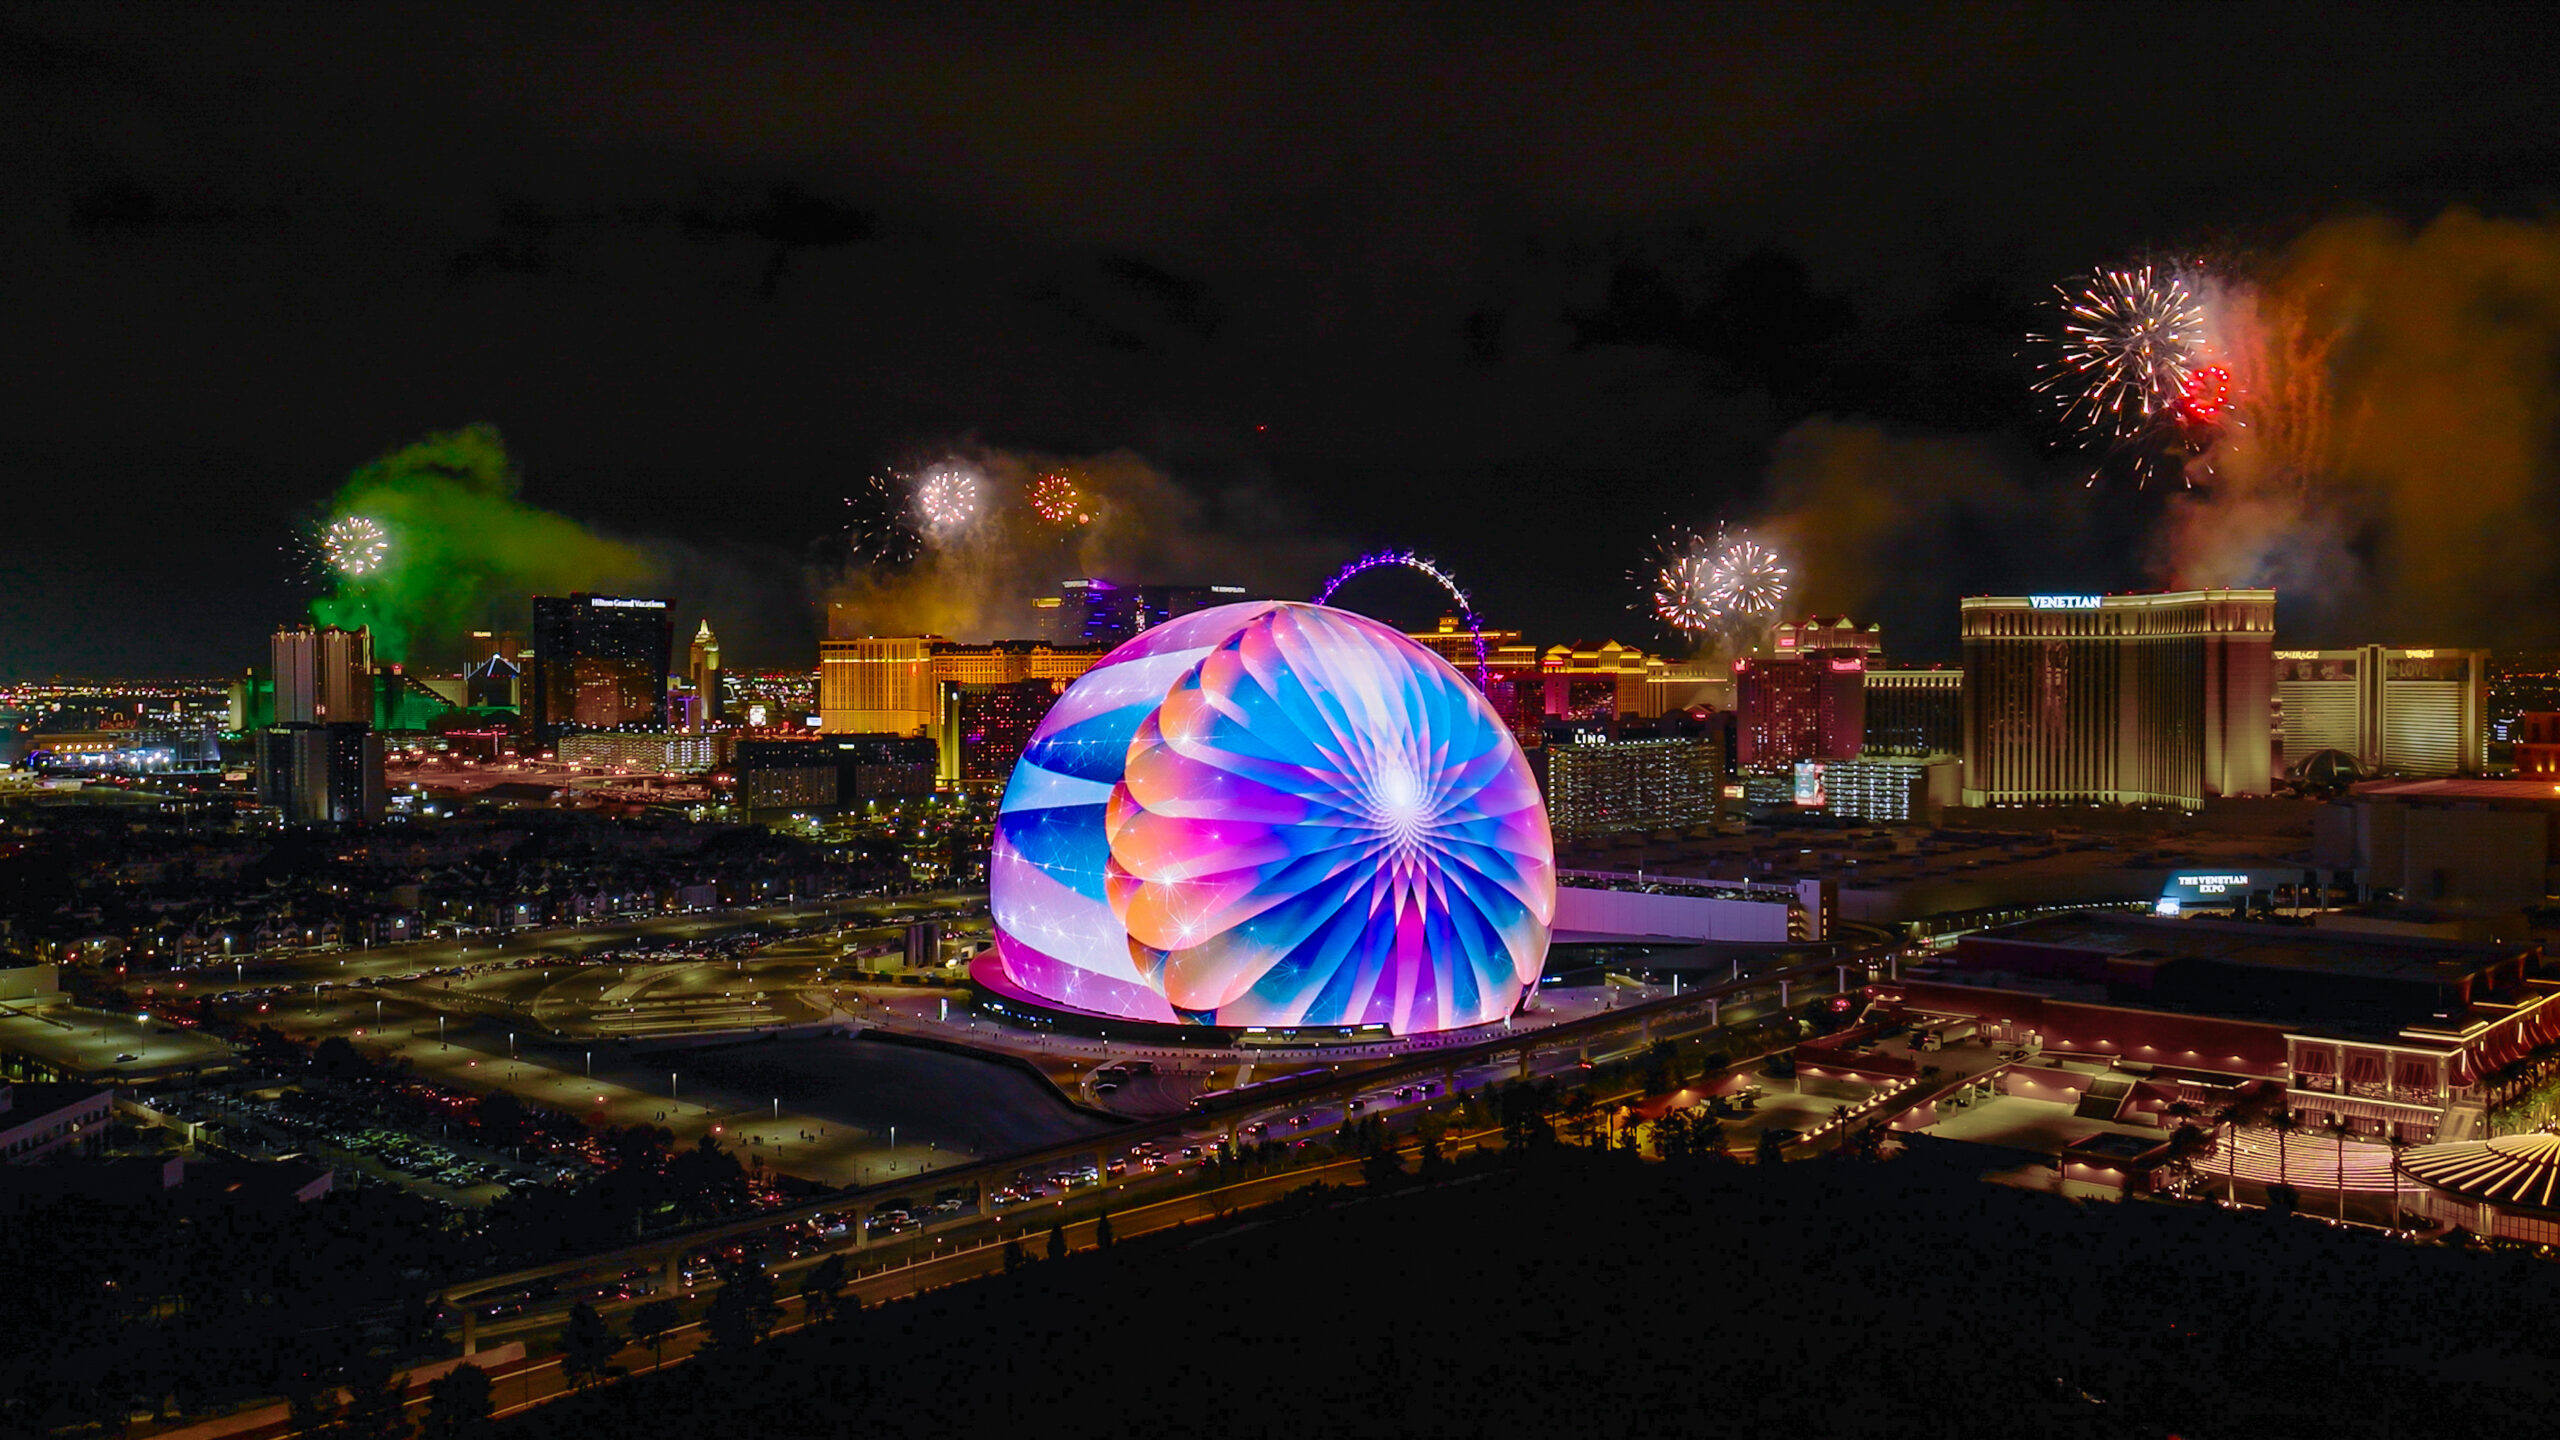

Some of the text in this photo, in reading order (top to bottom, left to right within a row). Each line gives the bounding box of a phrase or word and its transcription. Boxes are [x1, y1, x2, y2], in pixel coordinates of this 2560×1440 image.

[591, 598, 666, 608] Hilton Grand Vacations
[2028, 596, 2102, 609] VENETIAN
[2400, 662, 2429, 677] LOVE
[1574, 734, 1607, 744] LINQ
[2178, 875, 2248, 885] THE VENETIAN
[2199, 884, 2226, 893] EXPO
